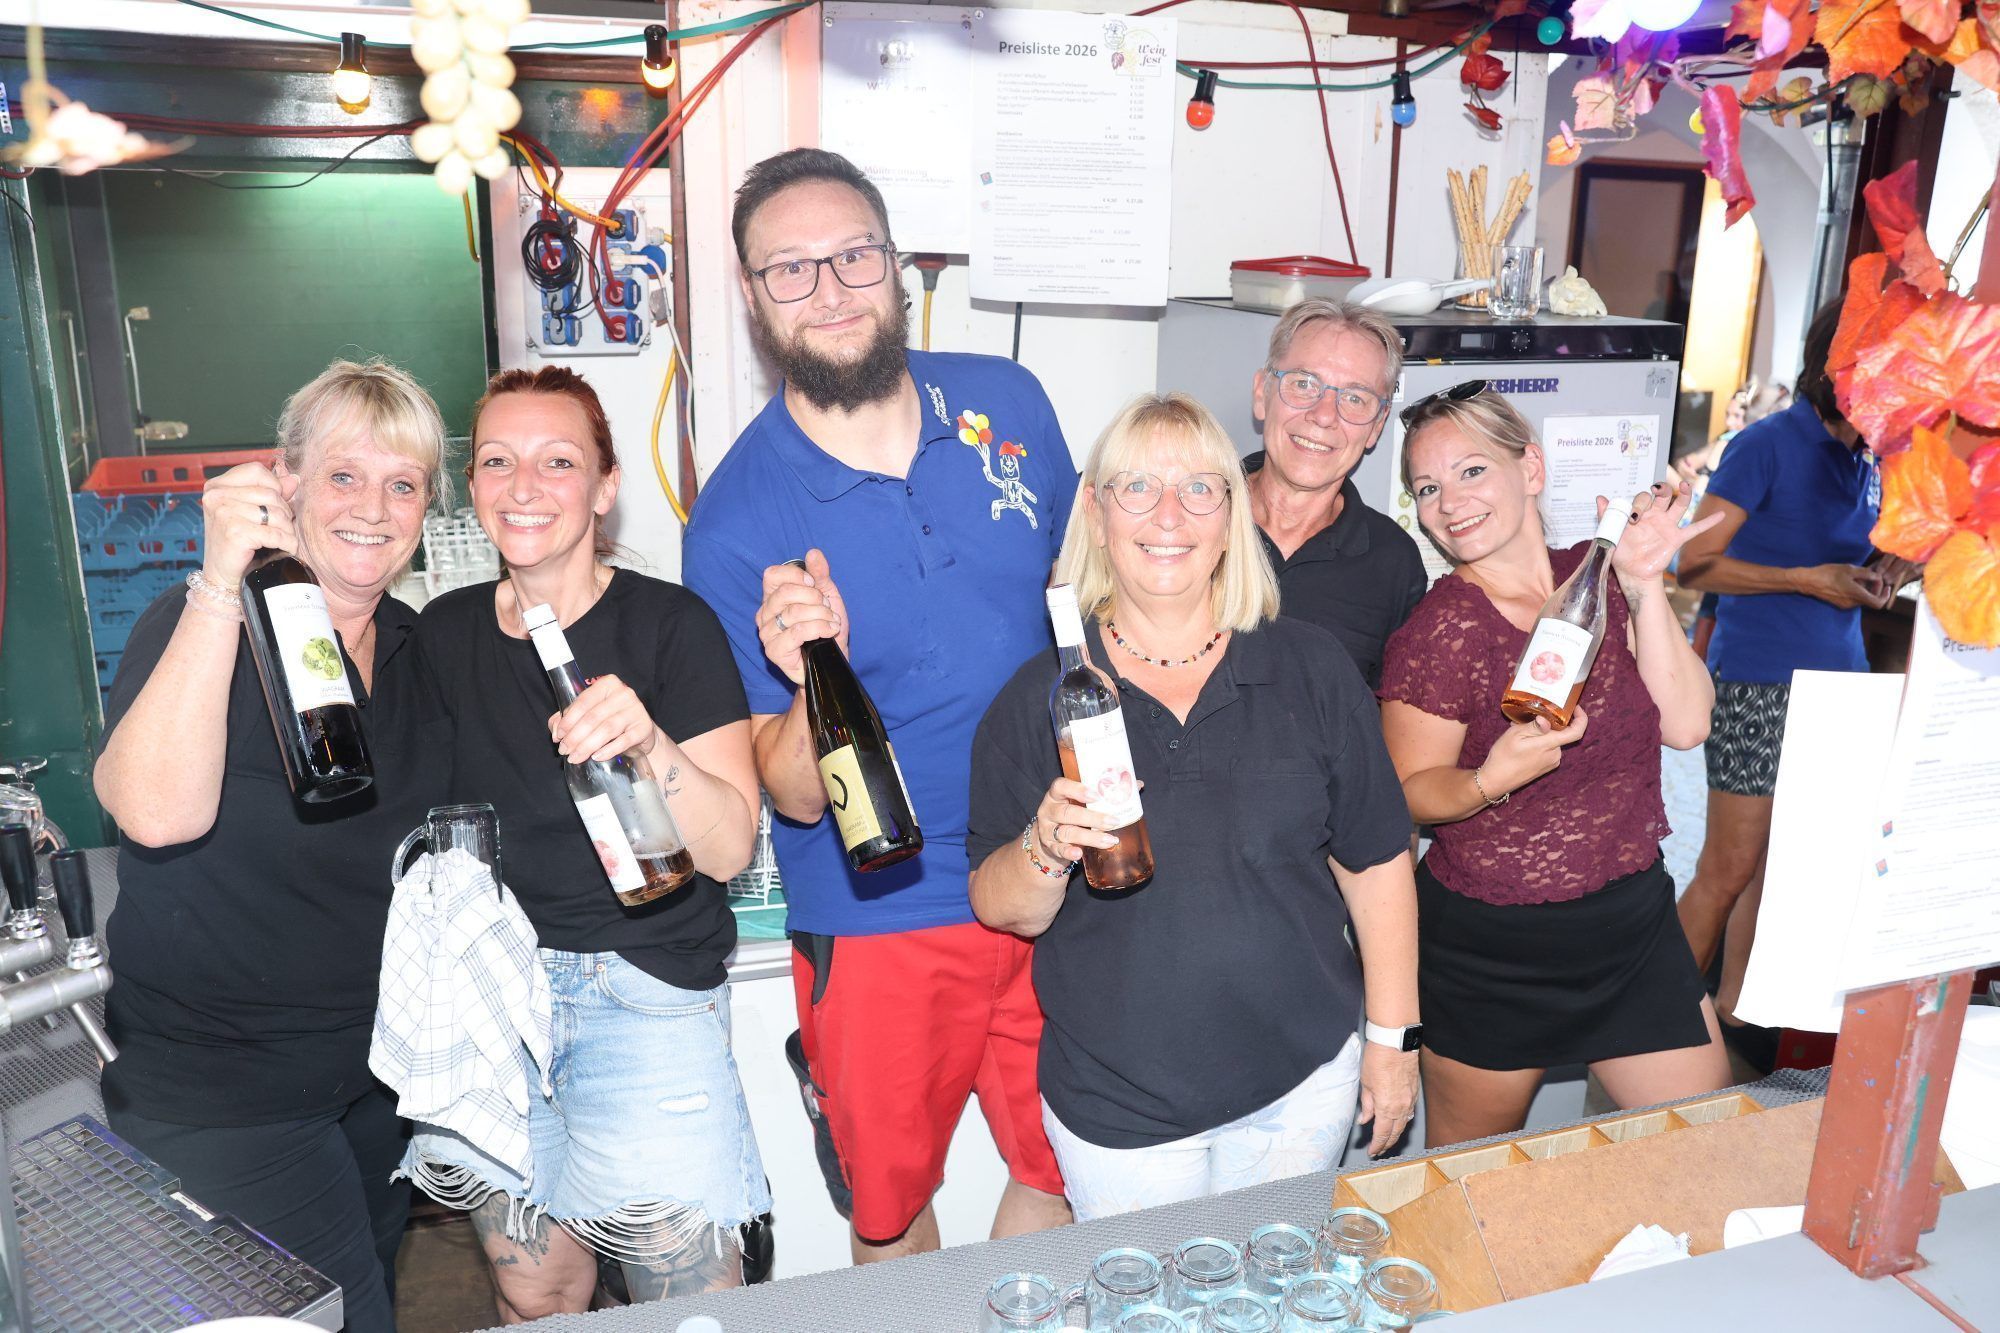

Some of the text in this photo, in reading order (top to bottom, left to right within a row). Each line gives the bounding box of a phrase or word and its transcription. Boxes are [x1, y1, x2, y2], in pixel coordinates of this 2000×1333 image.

[999, 41, 1098, 57] Preisliste 2026
[1138, 44, 1167, 57] Wein
[1139, 55, 1162, 67] fest
[1557, 437, 1614, 448] Preisliste 2026
